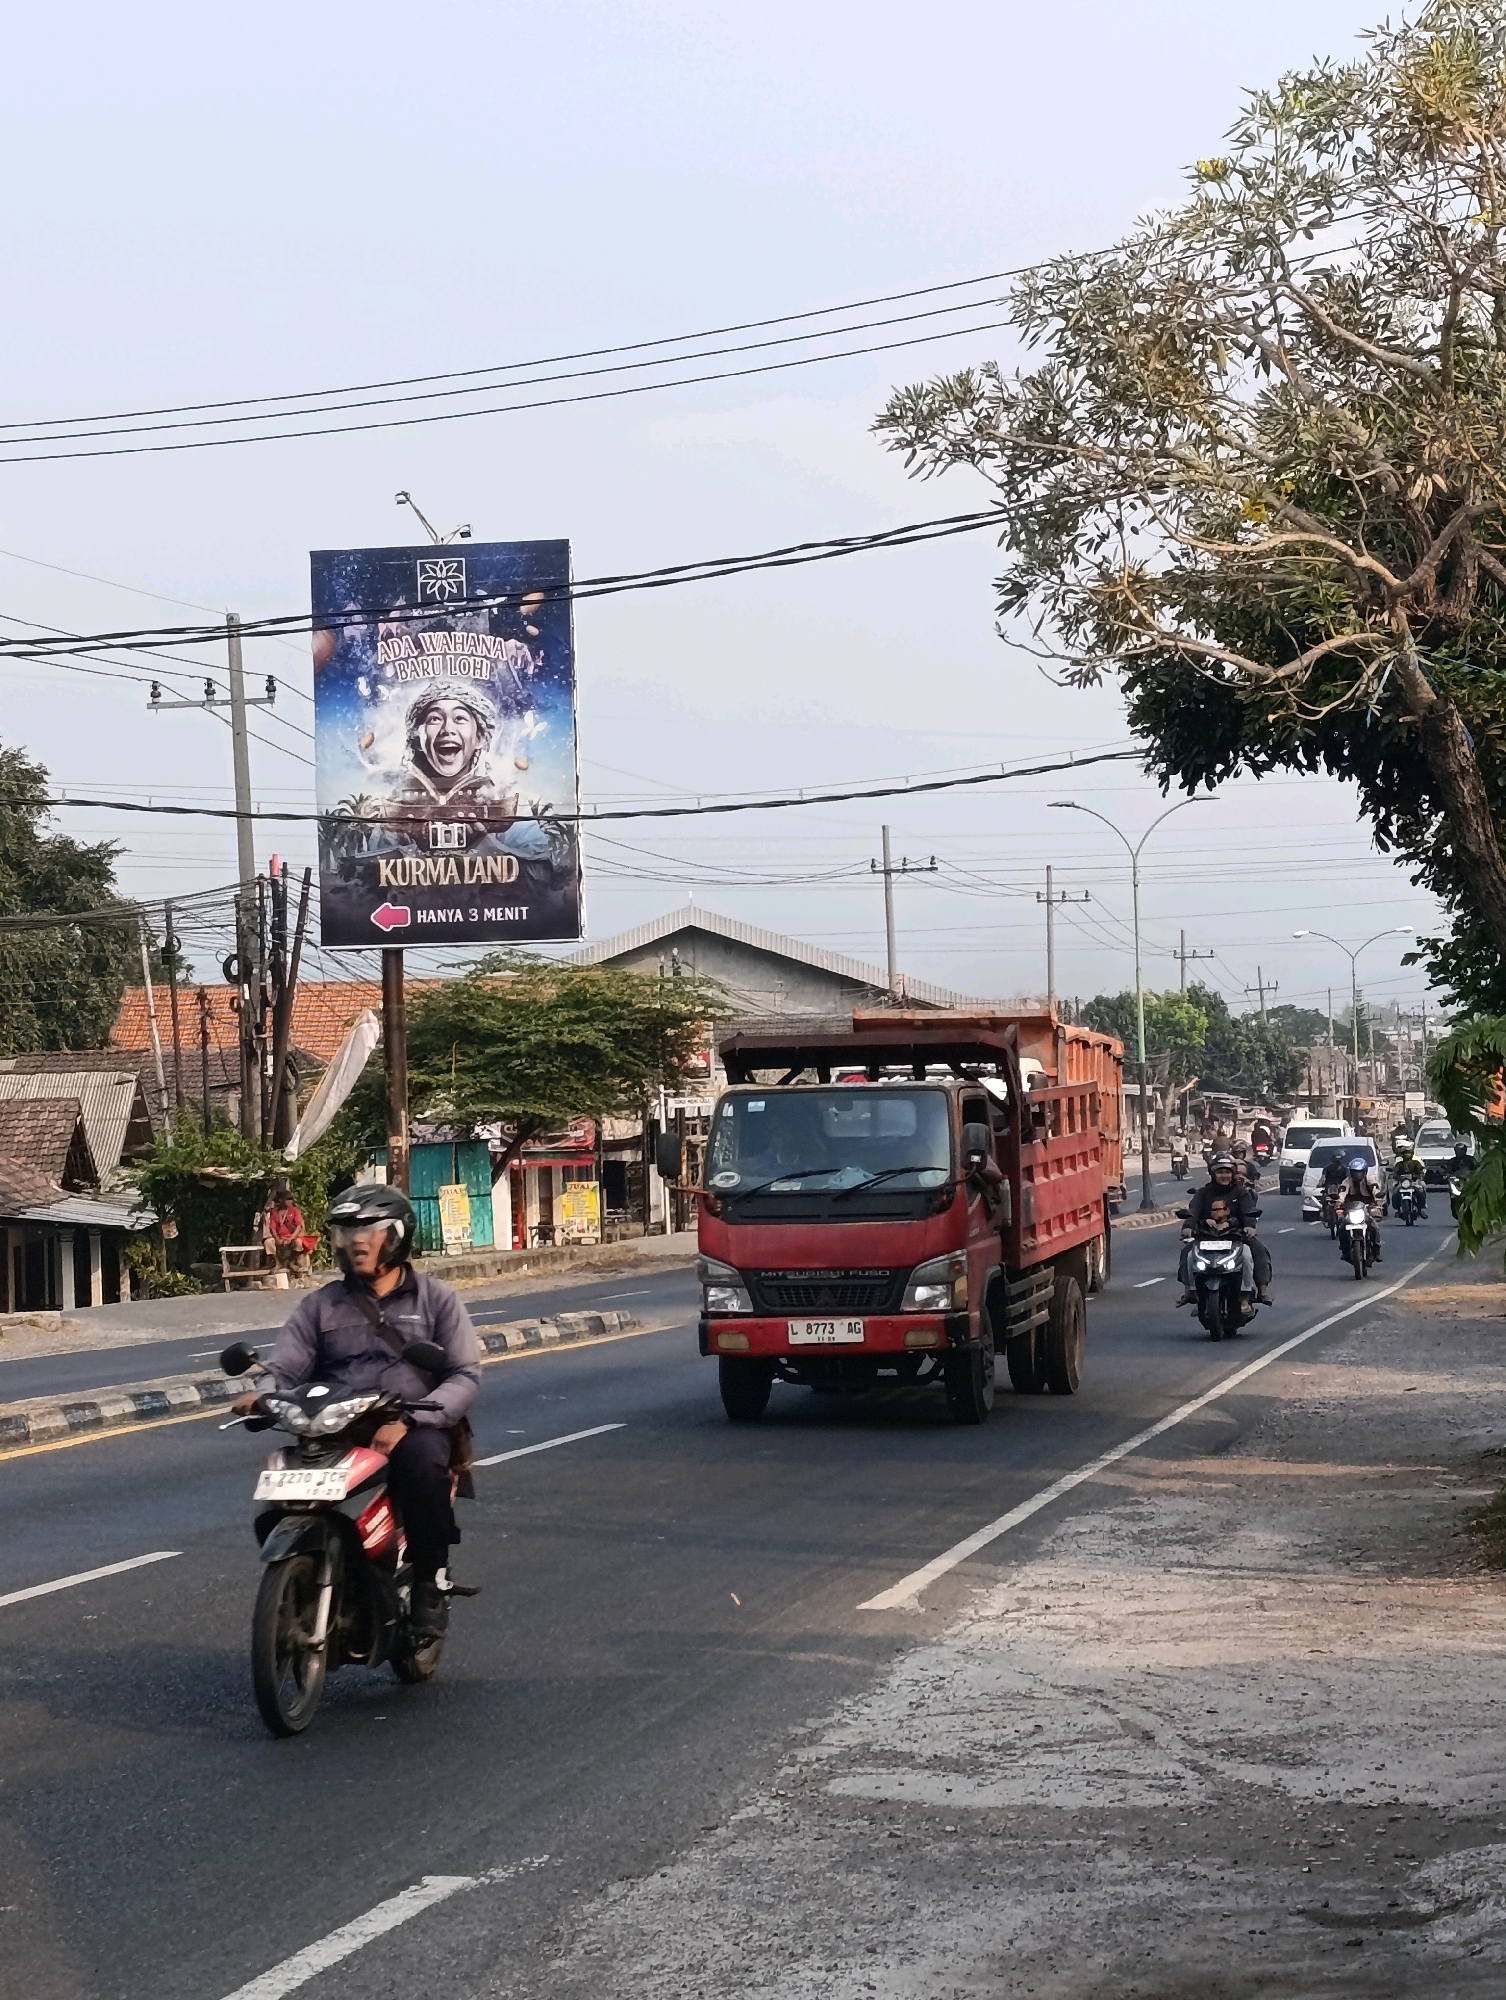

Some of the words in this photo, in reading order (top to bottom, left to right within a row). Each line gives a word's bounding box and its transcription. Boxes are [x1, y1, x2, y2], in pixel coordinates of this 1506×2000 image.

[377, 635, 418, 664] ADA
[418, 631, 507, 661] WAHANA
[395, 655, 442, 682] BARU
[446, 655, 490, 680] LOH!
[417, 908, 464, 924] HANYA
[468, 907, 478, 921] 3
[483, 906, 529, 921] MENIT
[790, 1323, 799, 1336] L
[806, 1322, 835, 1336] 8773
[847, 1321, 862, 1334] AG
